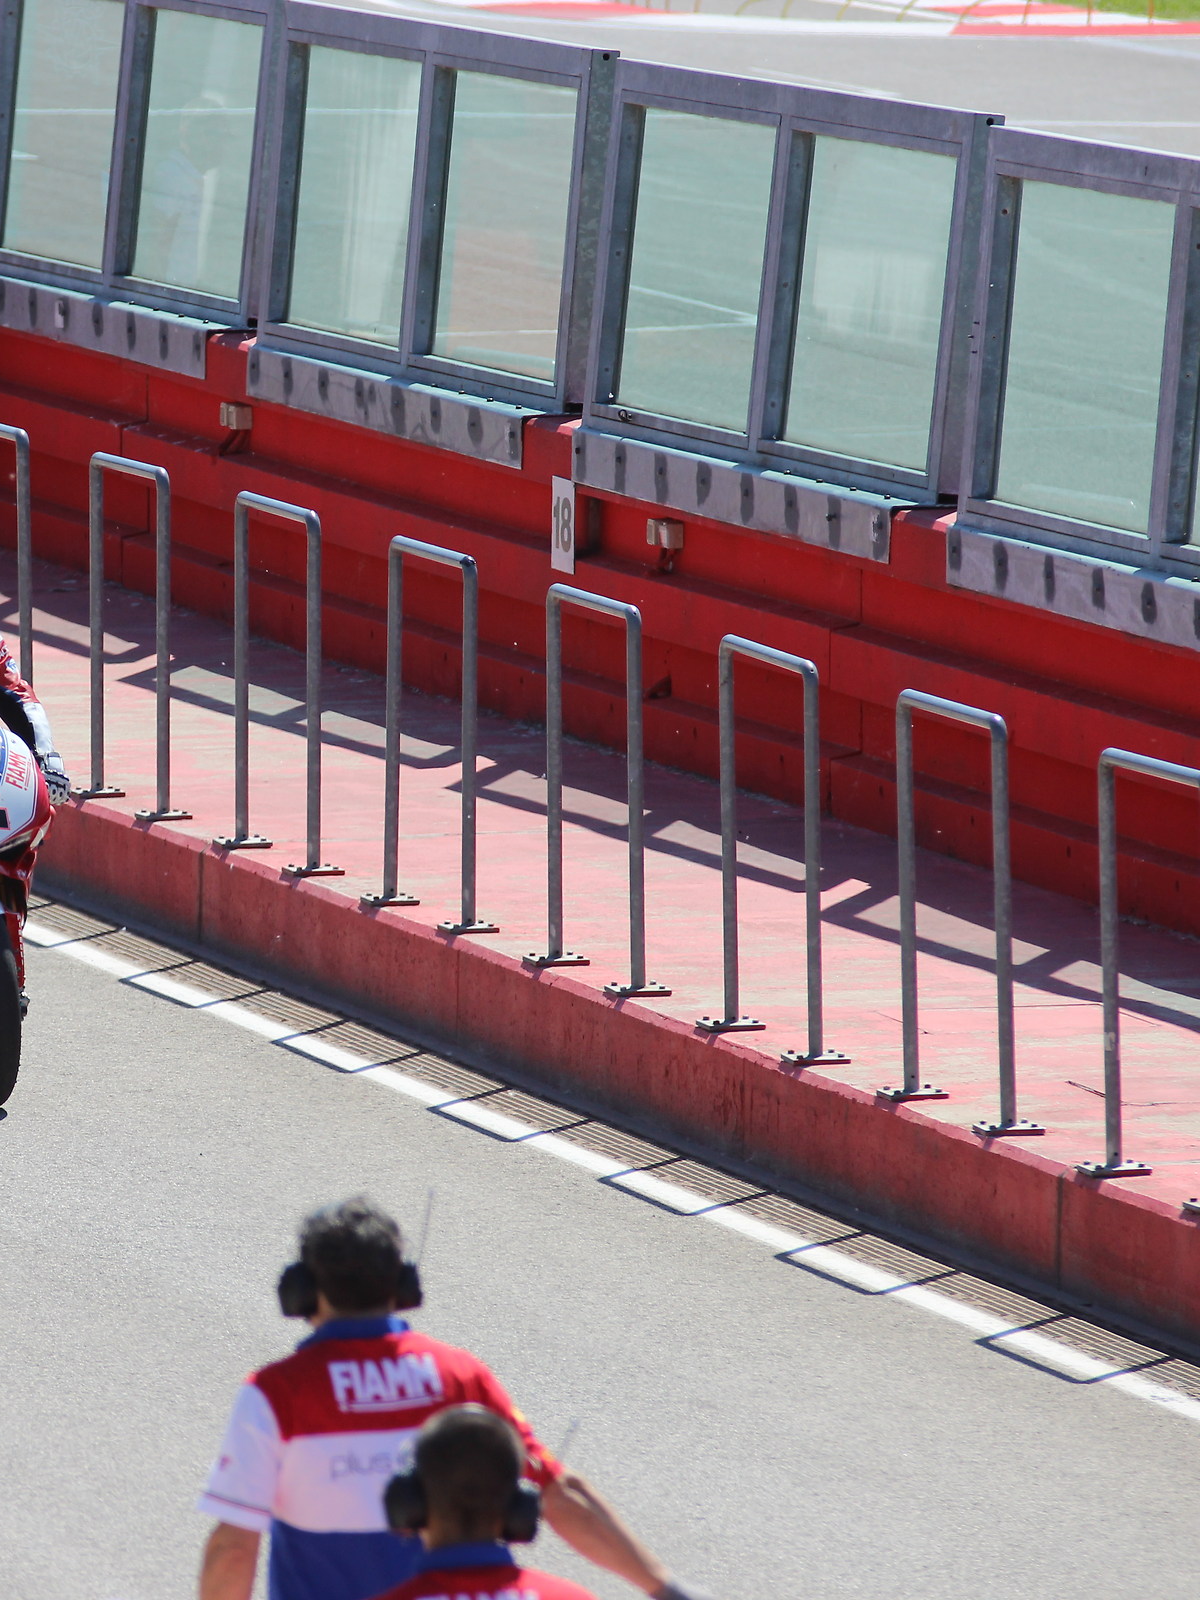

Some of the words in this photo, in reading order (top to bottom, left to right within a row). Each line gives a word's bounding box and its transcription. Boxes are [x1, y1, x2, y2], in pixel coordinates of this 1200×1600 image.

[554, 496, 572, 553] 18
[4, 750, 27, 790] FIAMM
[327, 1352, 444, 1406] FIAMM
